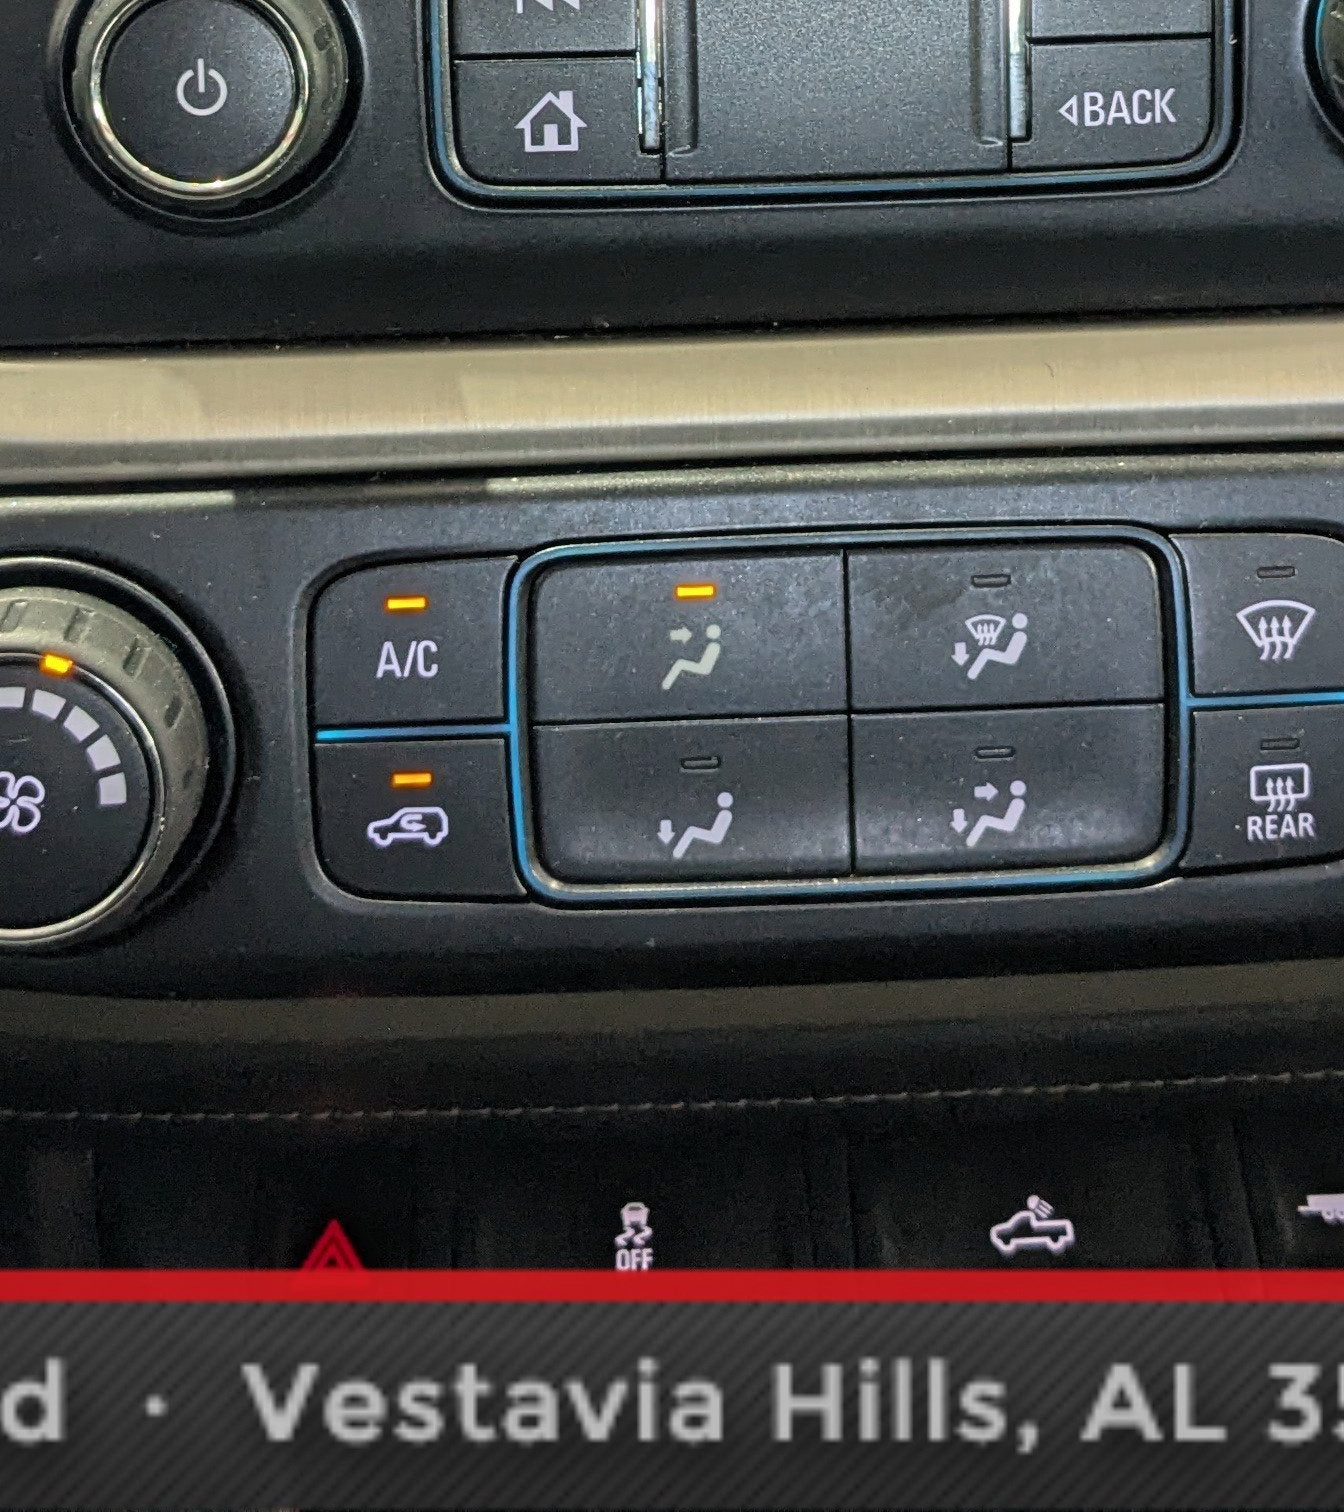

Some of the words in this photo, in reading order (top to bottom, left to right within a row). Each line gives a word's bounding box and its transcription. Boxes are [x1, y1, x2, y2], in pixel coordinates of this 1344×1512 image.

[1084, 88, 1178, 128] BACK
[375, 639, 440, 679] A/C
[1246, 811, 1316, 843] REAR
[615, 1248, 654, 1272] OFF
